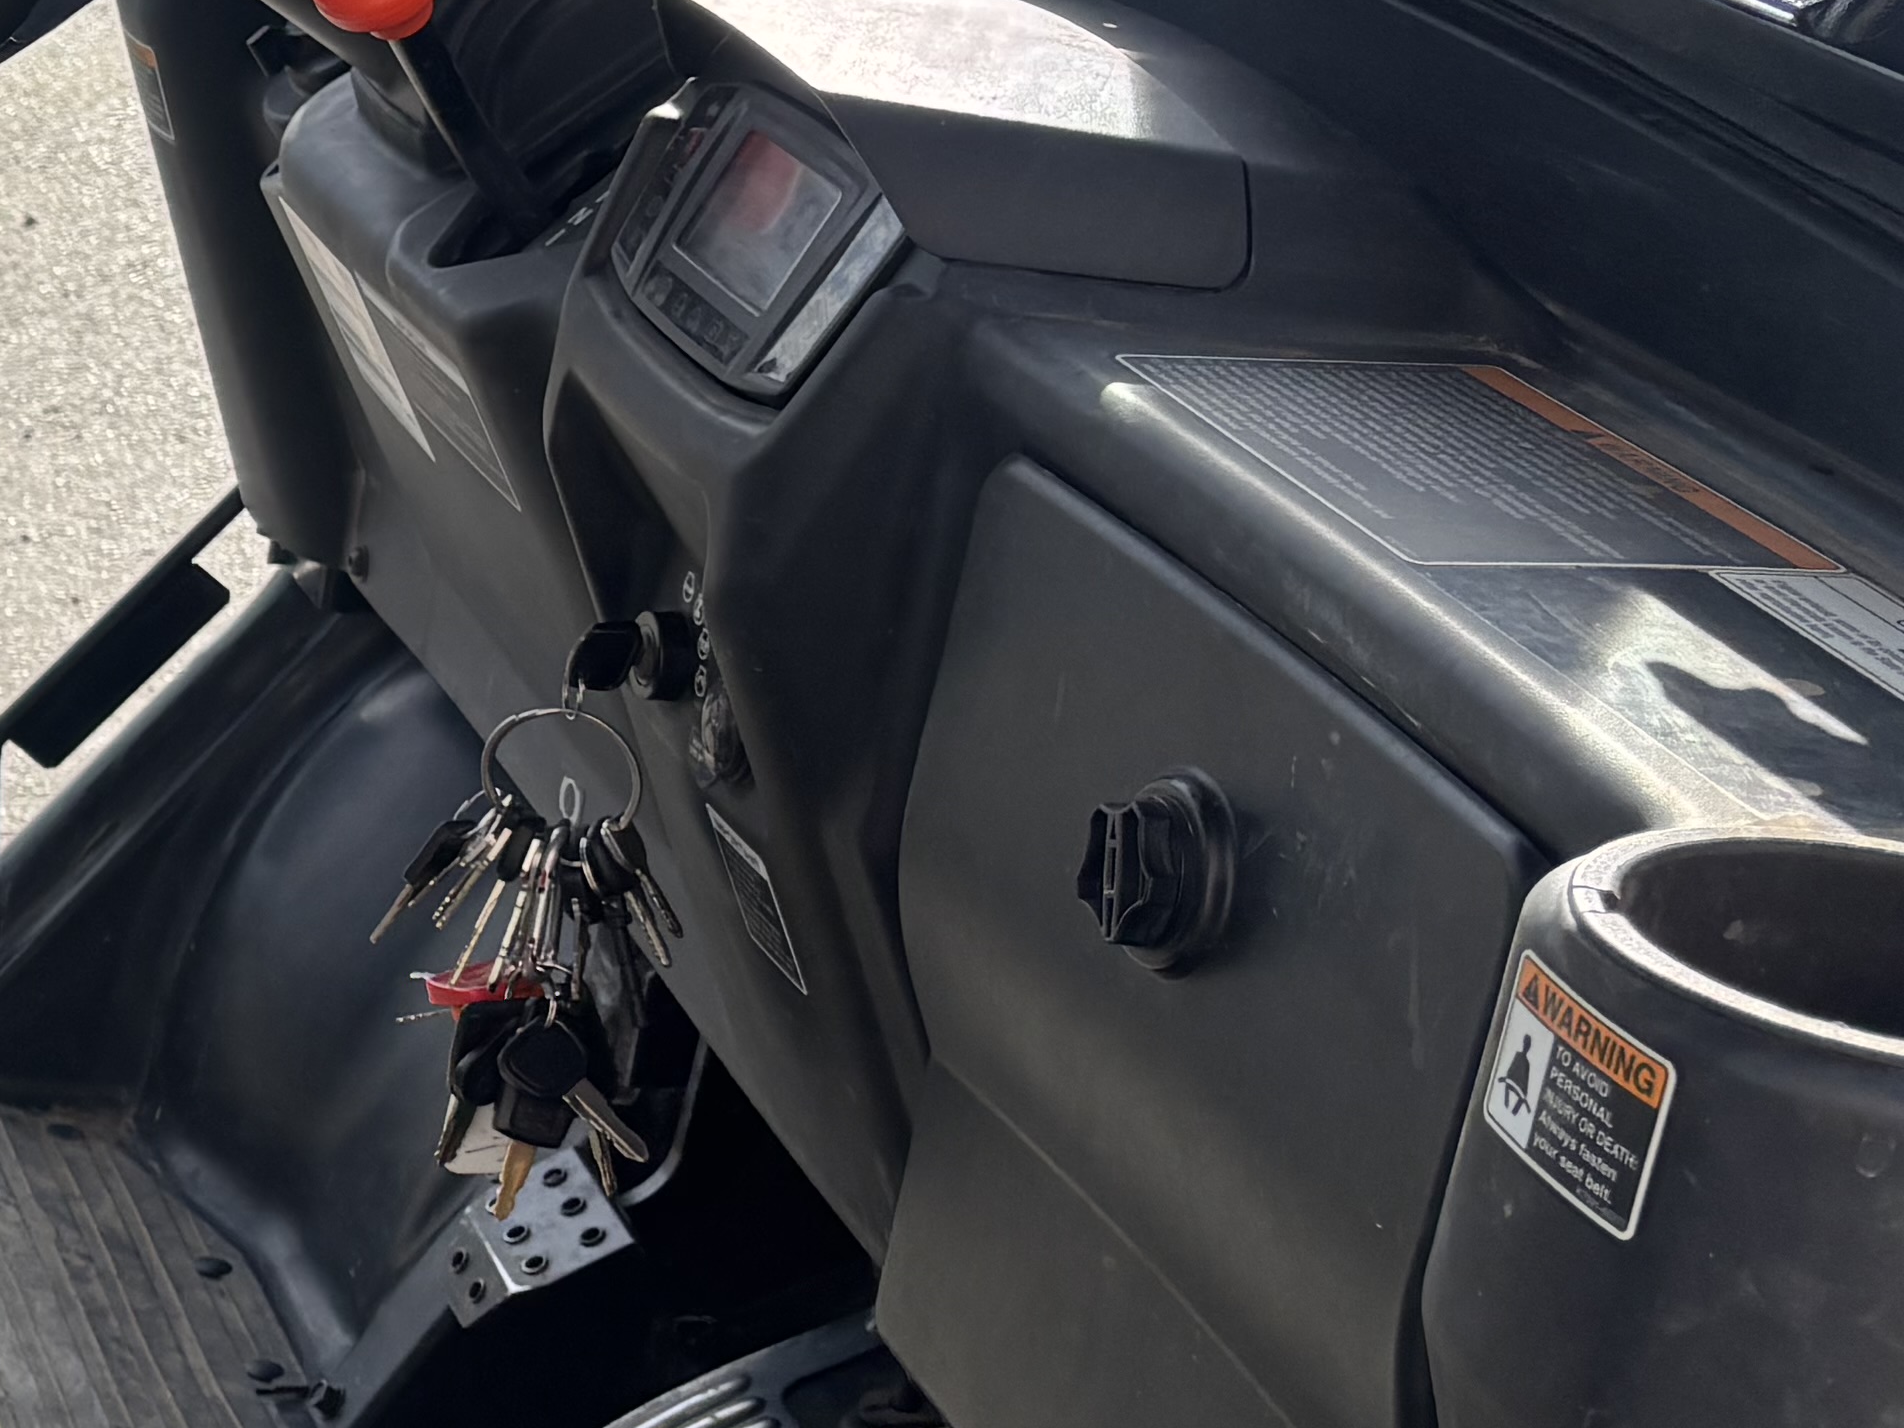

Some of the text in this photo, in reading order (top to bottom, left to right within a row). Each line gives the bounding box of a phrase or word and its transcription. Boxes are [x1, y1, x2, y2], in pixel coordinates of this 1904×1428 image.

[1539, 983, 1658, 1099] WARNING
[1555, 1045, 1610, 1098] TO AVOID
[1549, 1065, 1614, 1129] PERSONAL
[1578, 1117, 1597, 1140] OR
[1558, 1155, 1585, 1183] seat
[1578, 1142, 1618, 1182] fasten
